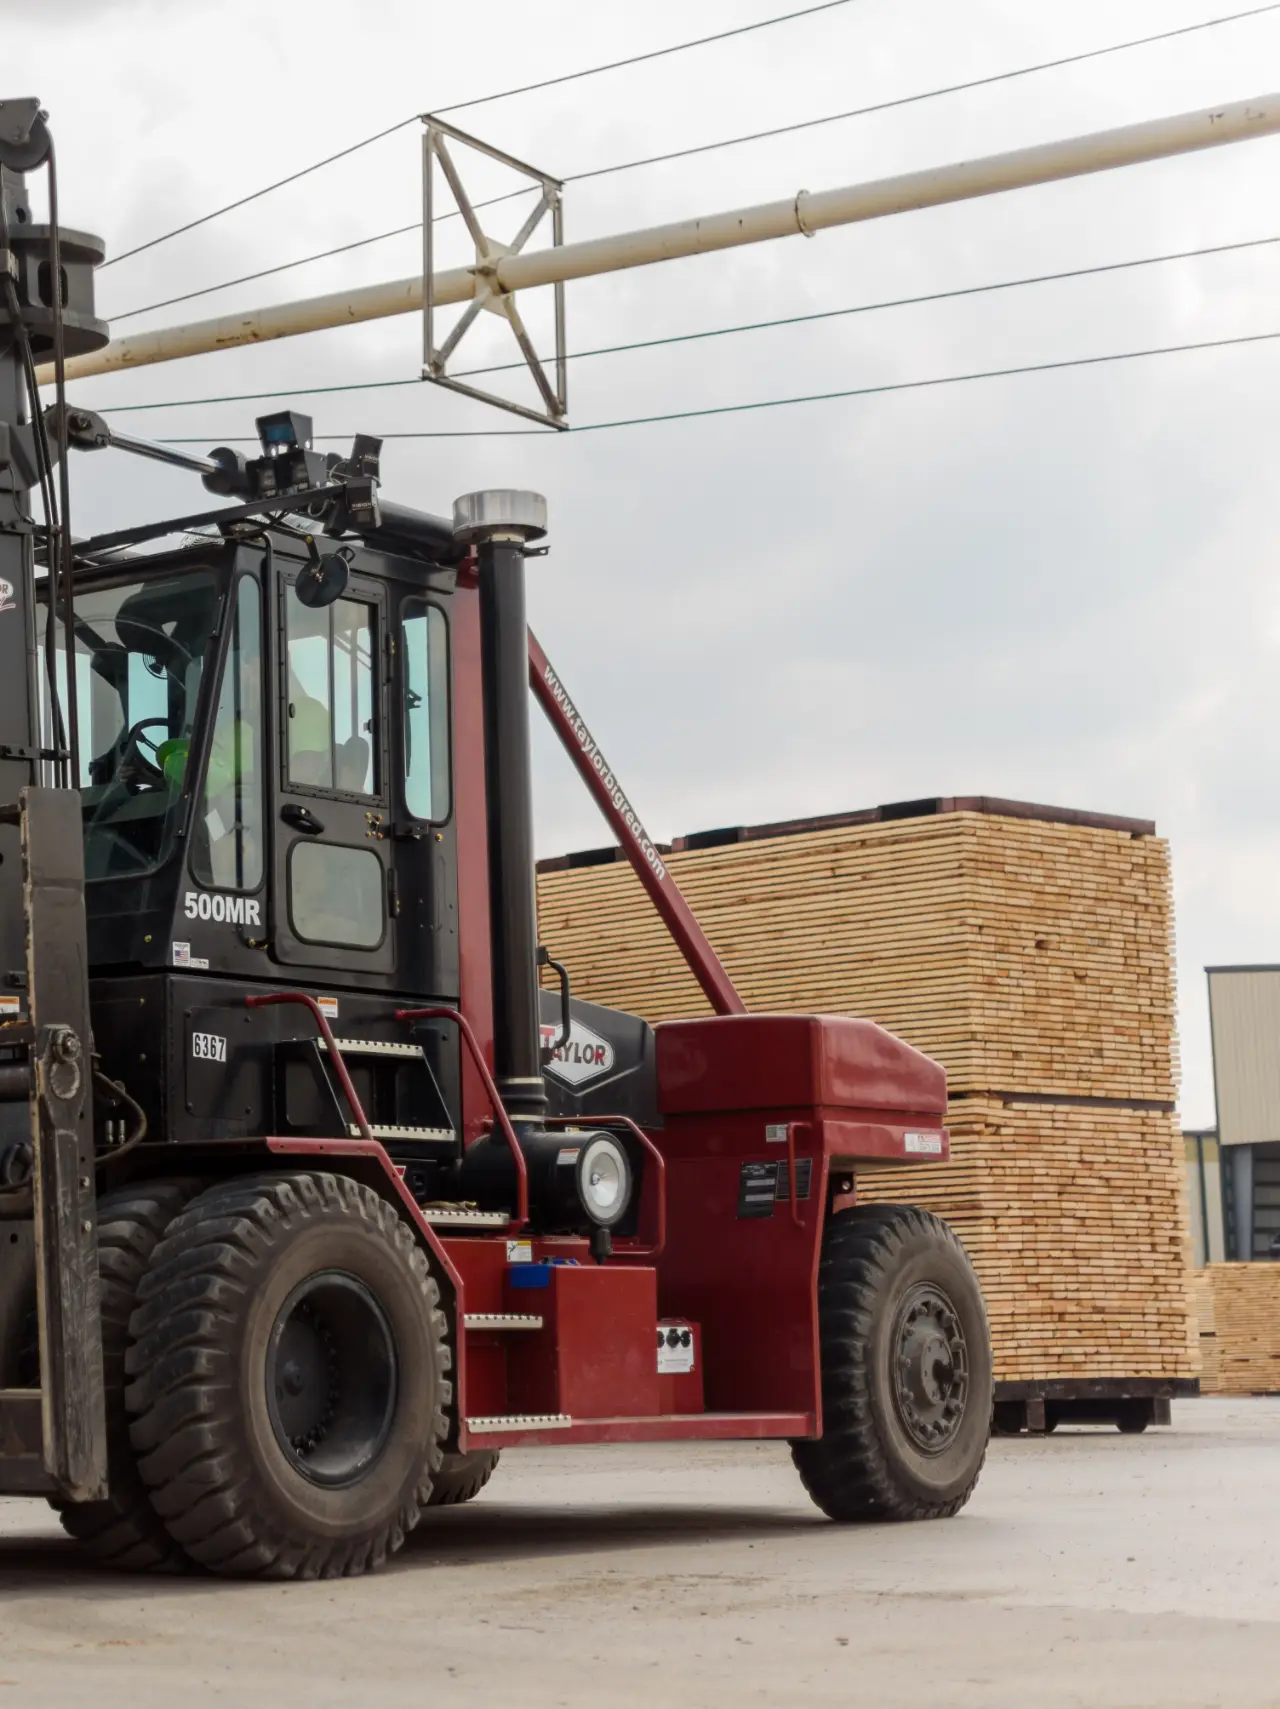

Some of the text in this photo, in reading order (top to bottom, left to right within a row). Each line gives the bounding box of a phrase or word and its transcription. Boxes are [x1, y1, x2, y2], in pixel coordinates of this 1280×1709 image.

[543, 664, 665, 881] www.taylorbigred.com
[184, 891, 261, 926] 500MR
[194, 1034, 226, 1061] 6367
